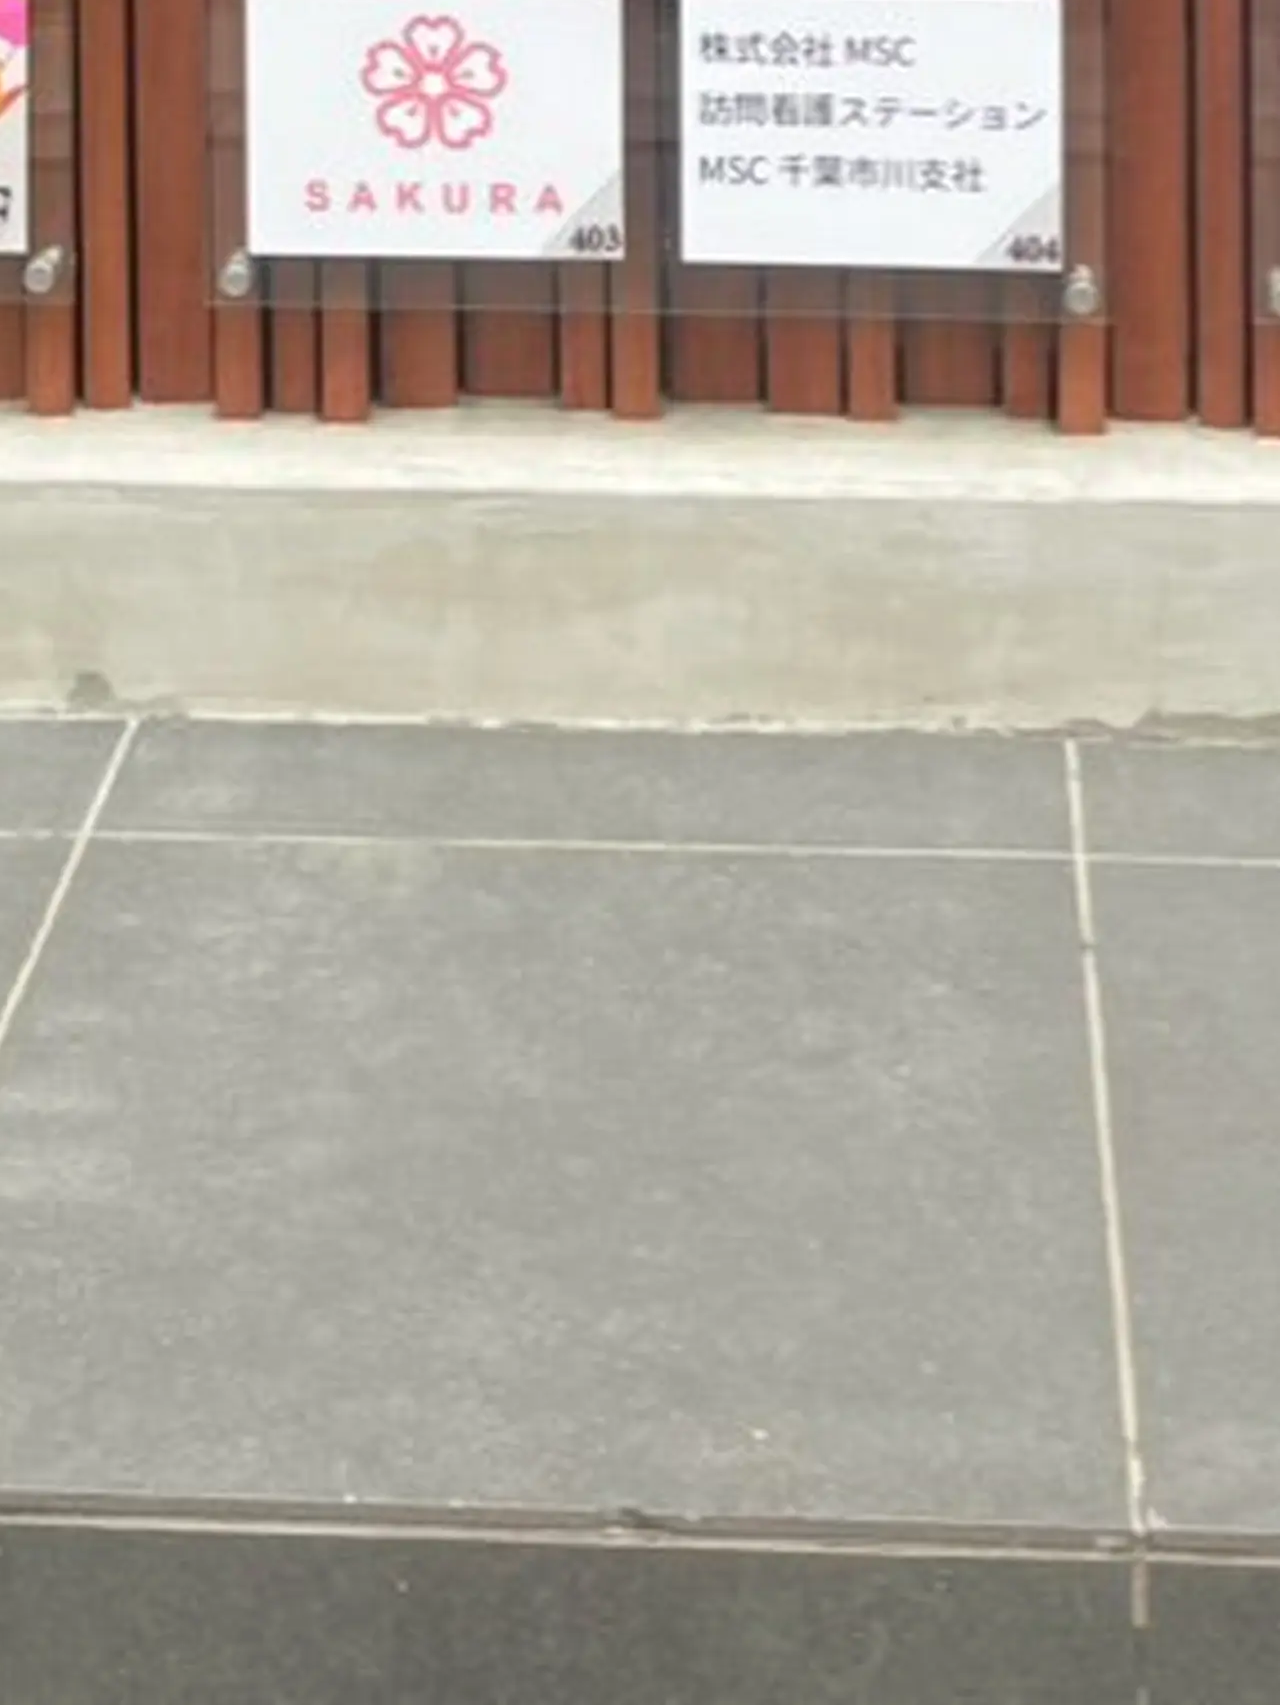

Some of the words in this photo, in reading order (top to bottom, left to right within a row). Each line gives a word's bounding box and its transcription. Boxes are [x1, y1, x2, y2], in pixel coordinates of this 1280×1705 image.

[699, 31, 833, 68] 株式会社
[845, 35, 917, 68] MSC
[699, 155, 769, 186] MSC
[305, 179, 564, 215] SAKURA
[568, 224, 620, 253] 403
